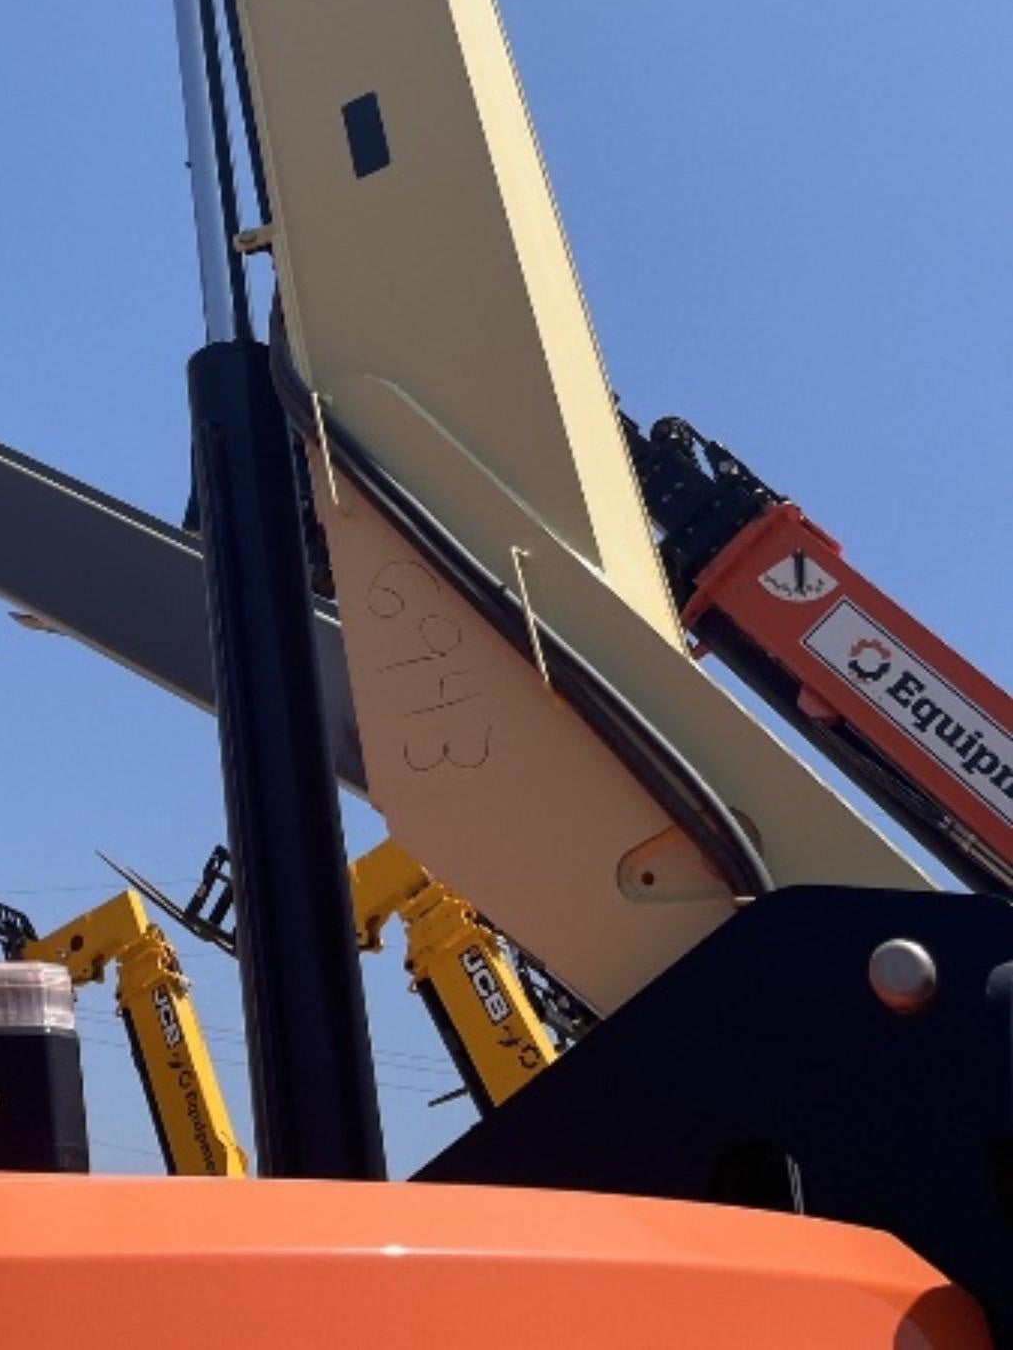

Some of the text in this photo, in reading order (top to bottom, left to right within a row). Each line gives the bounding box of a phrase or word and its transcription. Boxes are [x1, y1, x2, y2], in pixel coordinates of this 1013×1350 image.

[367, 559, 492, 772] 6943
[154, 984, 183, 1048] JCB
[460, 946, 511, 1025] JCB
